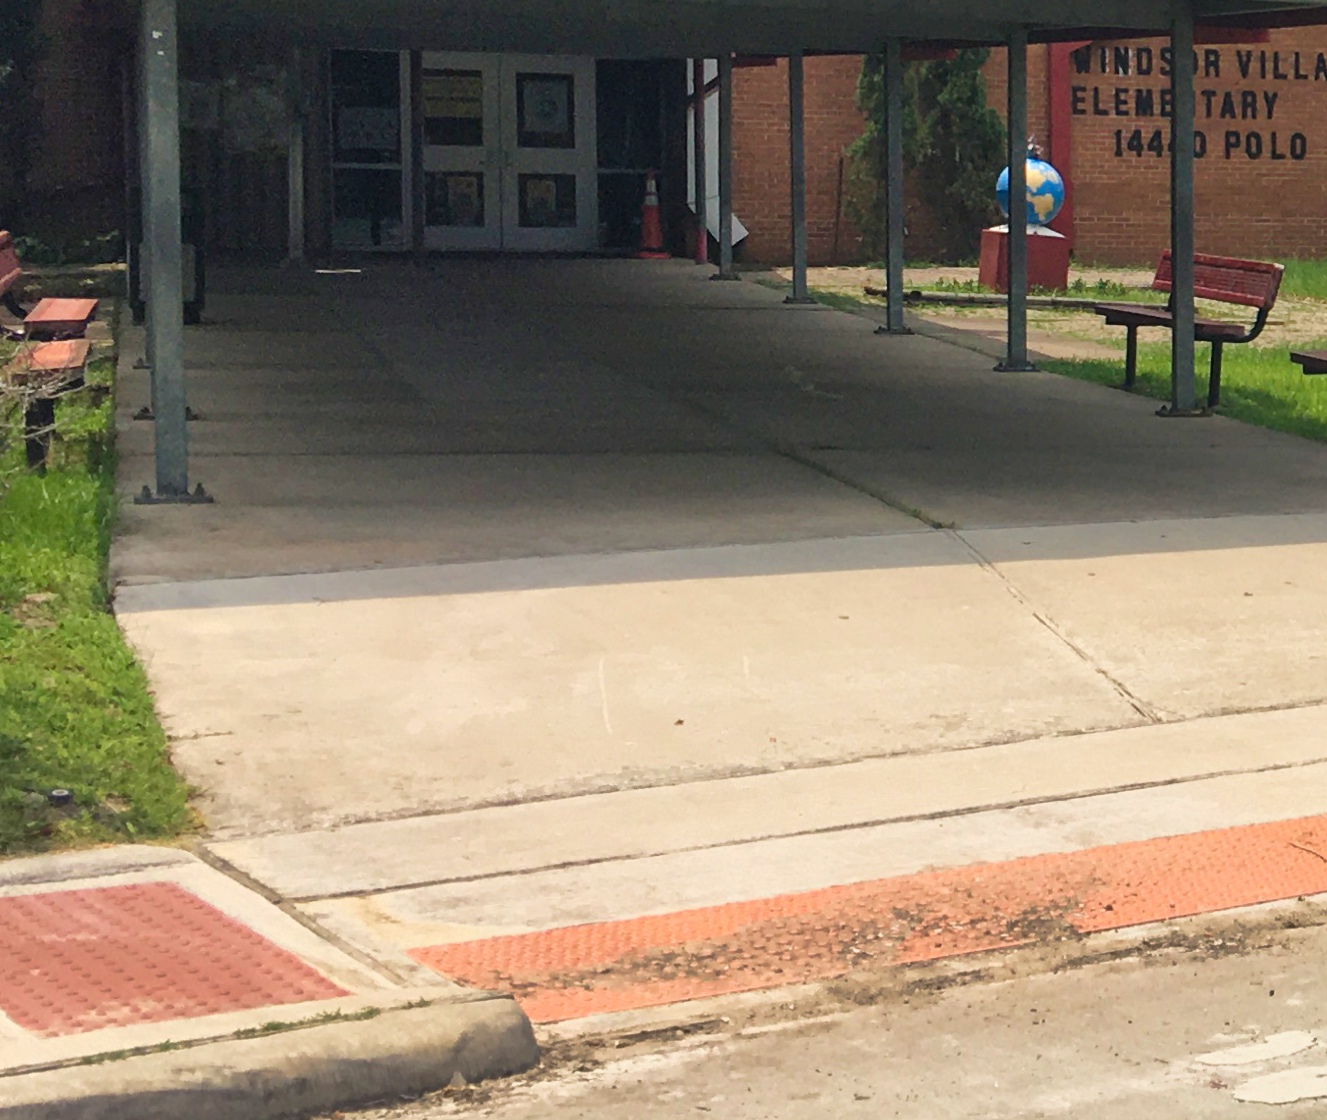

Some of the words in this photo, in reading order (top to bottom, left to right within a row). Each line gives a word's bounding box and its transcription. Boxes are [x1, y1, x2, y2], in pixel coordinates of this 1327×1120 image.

[1071, 86, 1279, 120] ELEMETARY
[1114, 129, 1207, 158] 1440
[1225, 130, 1307, 160] POLO
